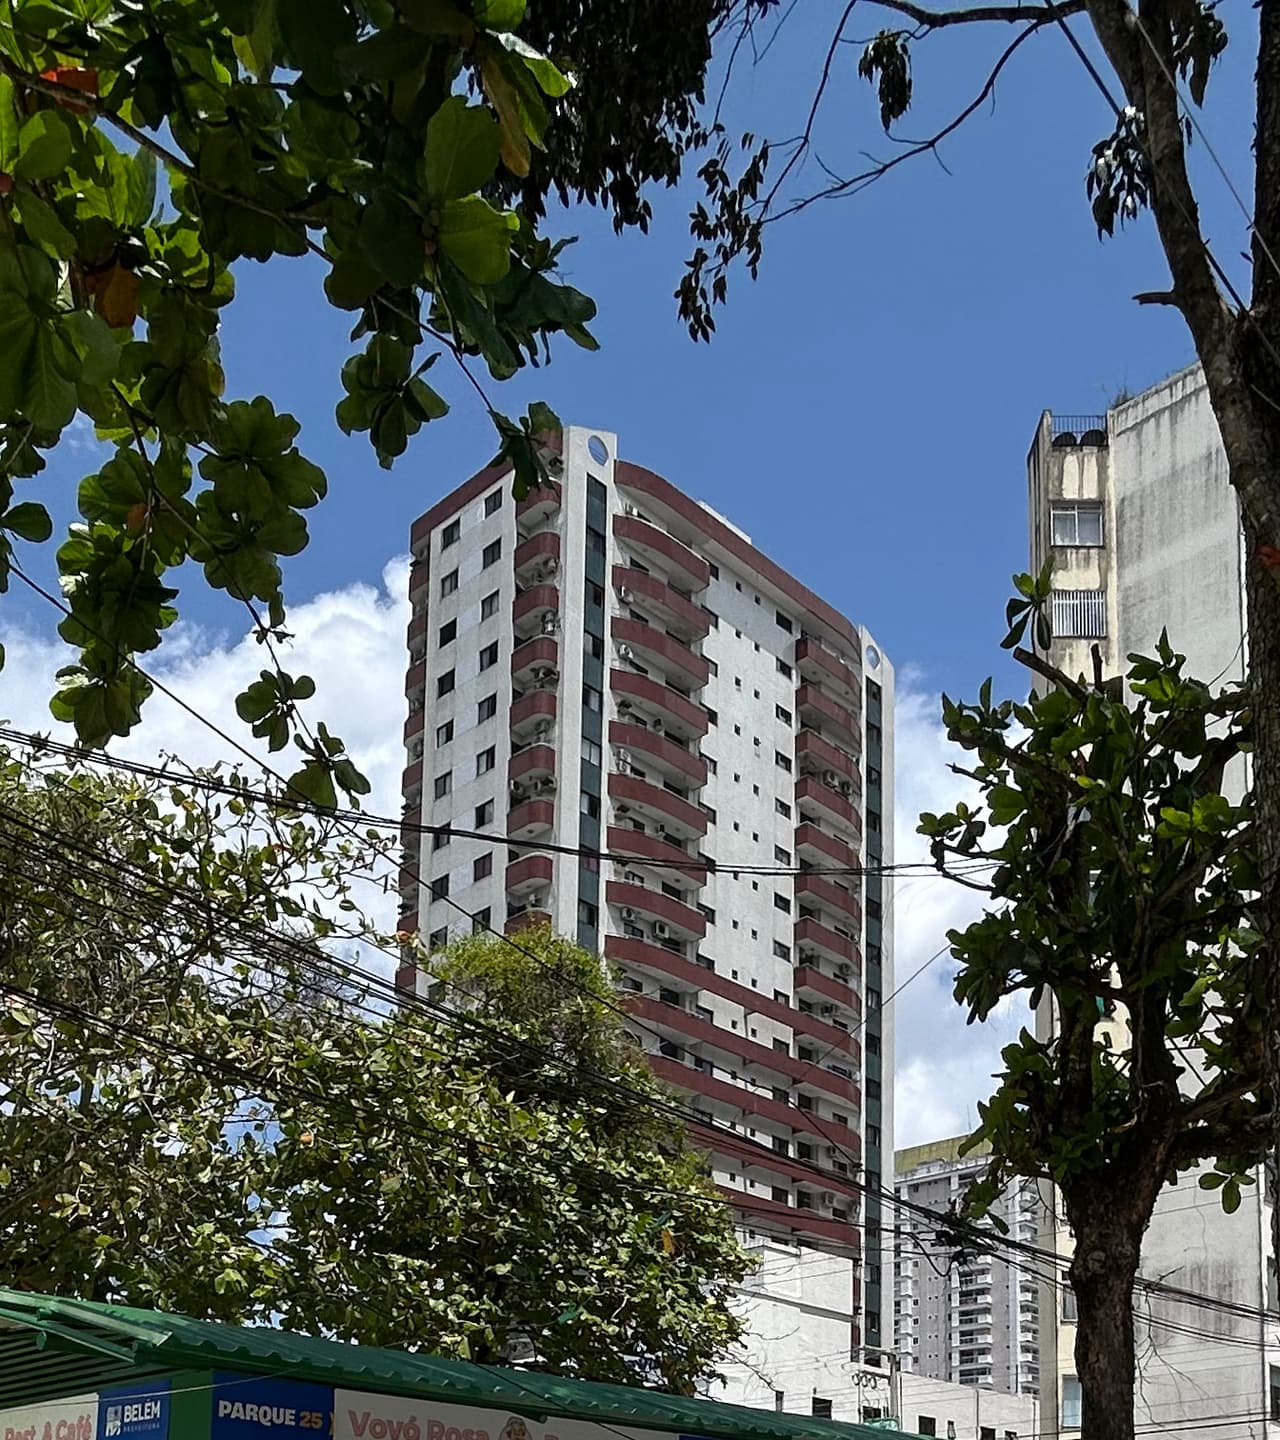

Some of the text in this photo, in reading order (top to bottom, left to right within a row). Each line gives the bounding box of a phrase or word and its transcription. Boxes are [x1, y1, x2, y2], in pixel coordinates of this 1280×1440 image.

[123, 1398, 161, 1424] BELÉM
[218, 1400, 324, 1429] PARQUE 25
